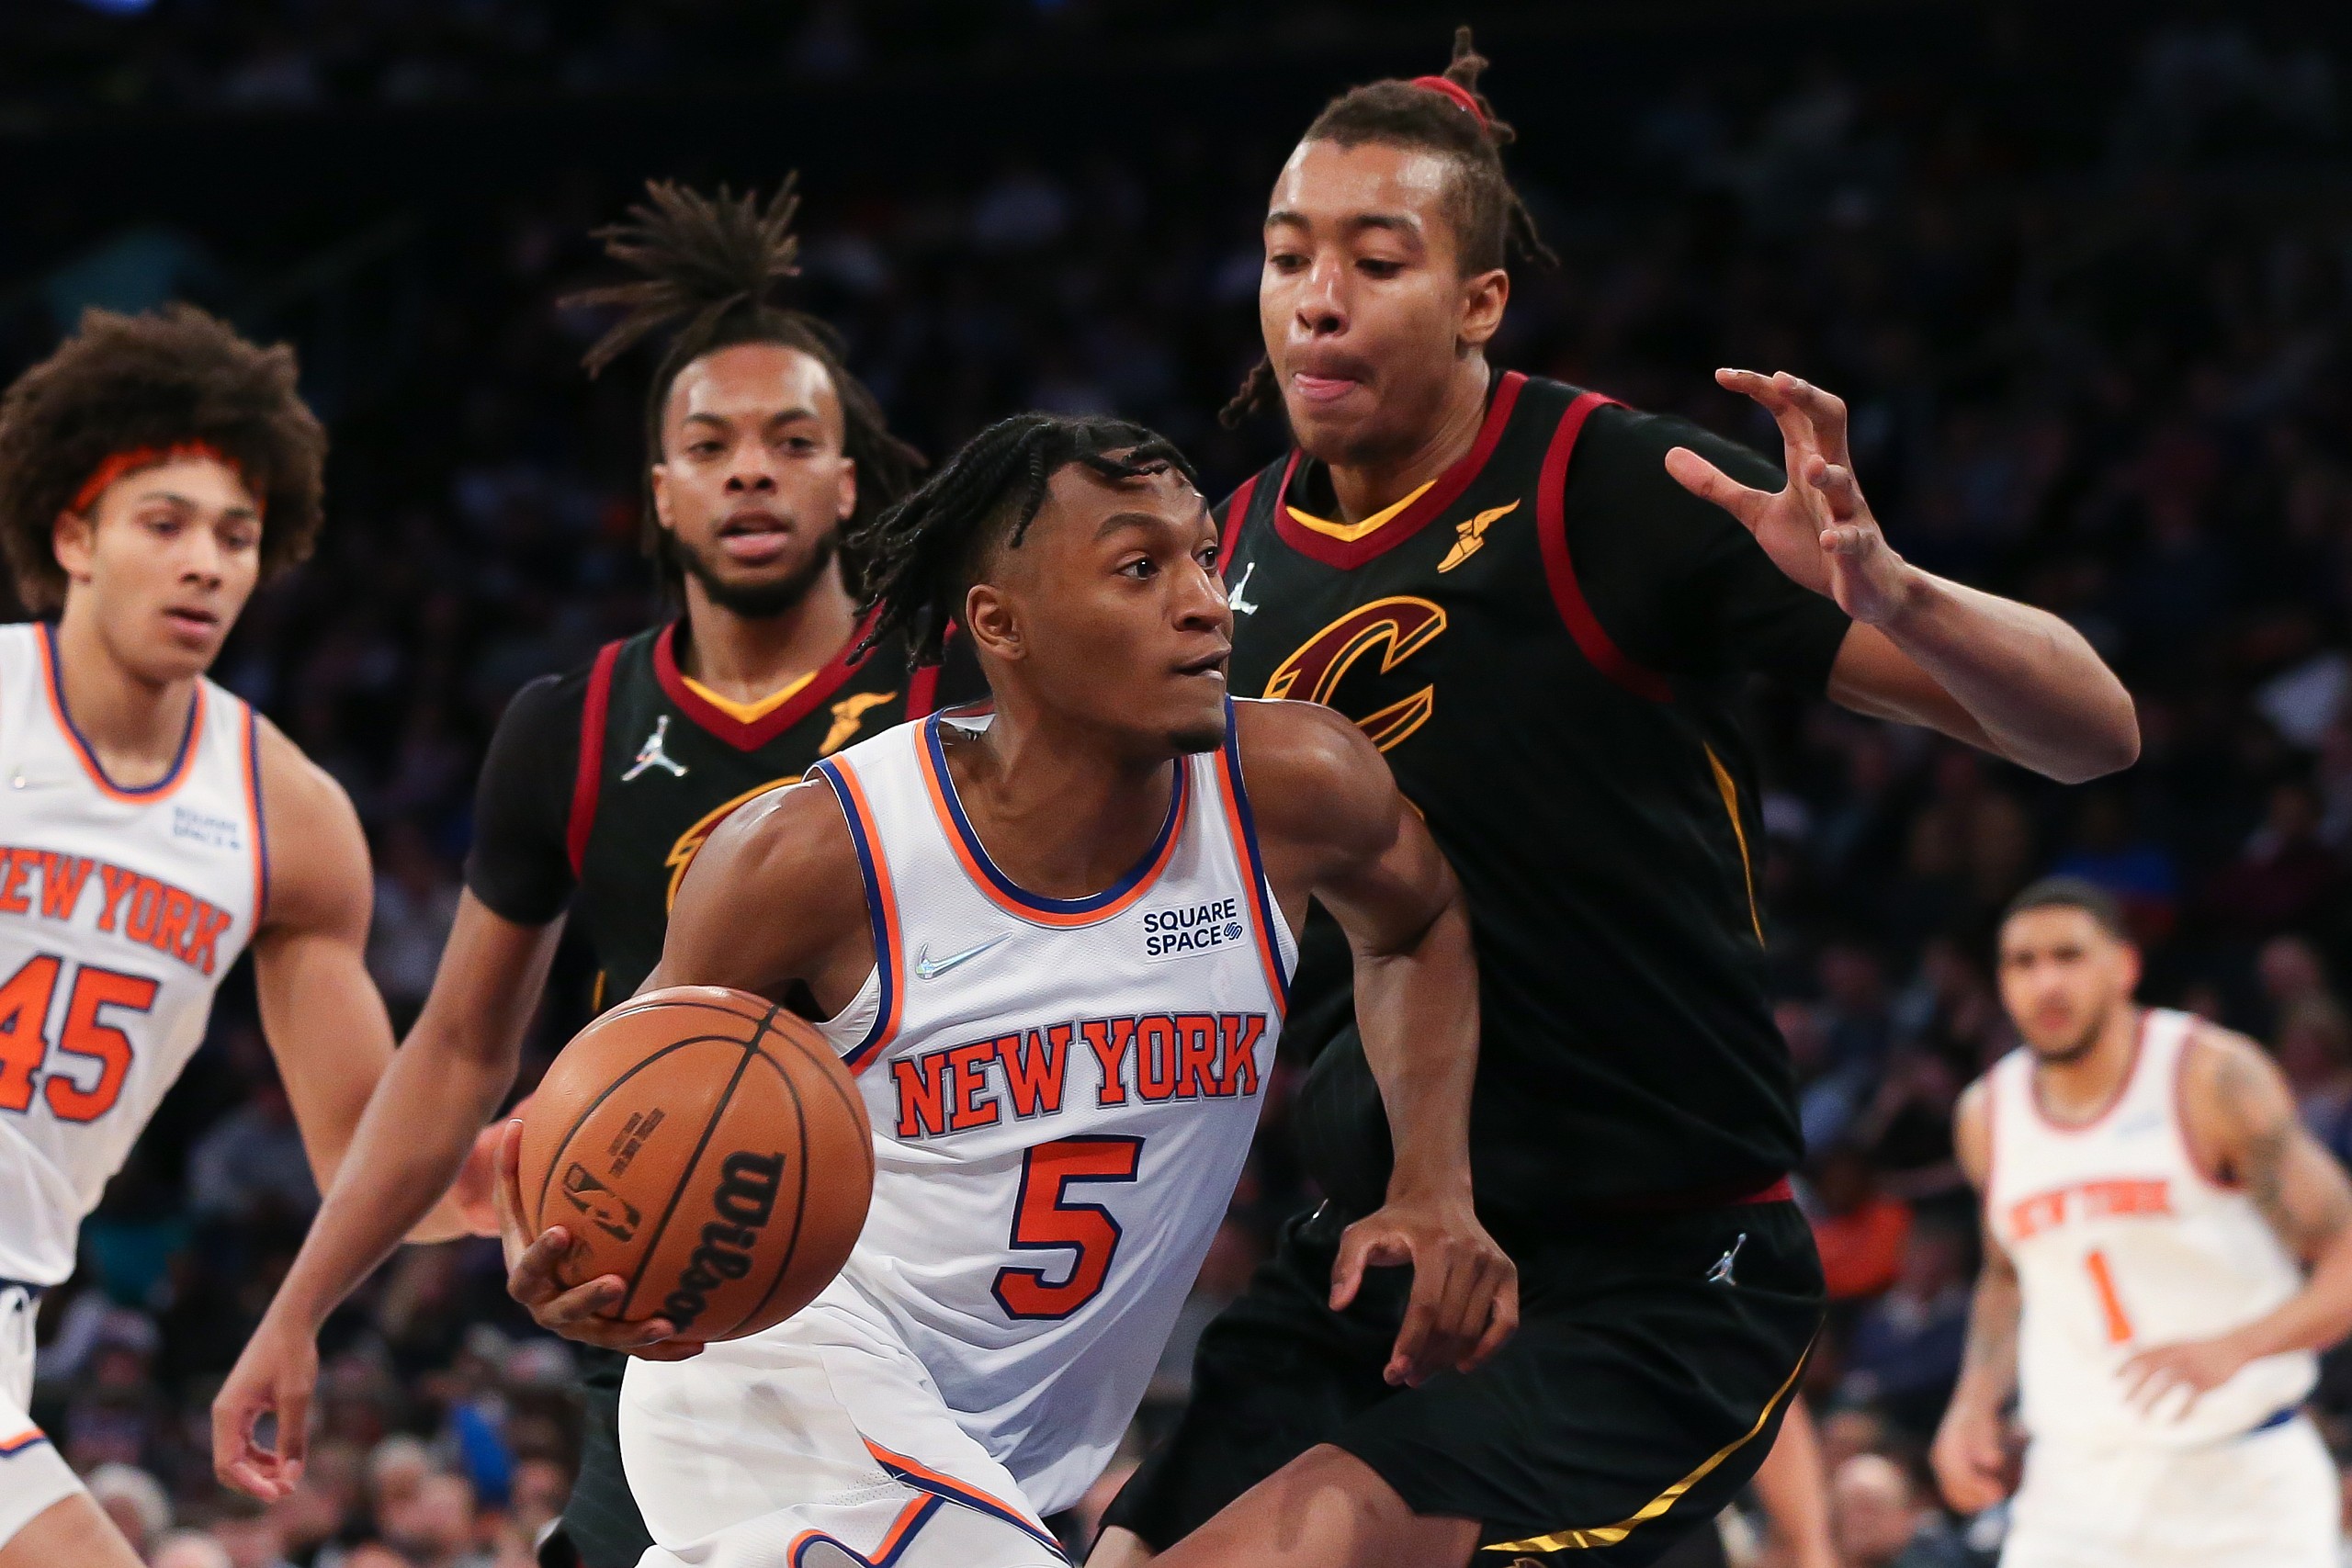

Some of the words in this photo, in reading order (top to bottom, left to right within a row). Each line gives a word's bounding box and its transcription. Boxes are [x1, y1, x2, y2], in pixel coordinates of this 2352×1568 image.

[96, 861, 233, 976] YORK
[1144, 898, 1237, 933] SQUARE
[1147, 925, 1223, 956] SPACE
[0, 950, 162, 1123] 45
[888, 1020, 1076, 1141] NEW
[1077, 1012, 1269, 1110] YORK
[990, 1134, 1146, 1321] 5
[2085, 1249, 2133, 1344] 1
